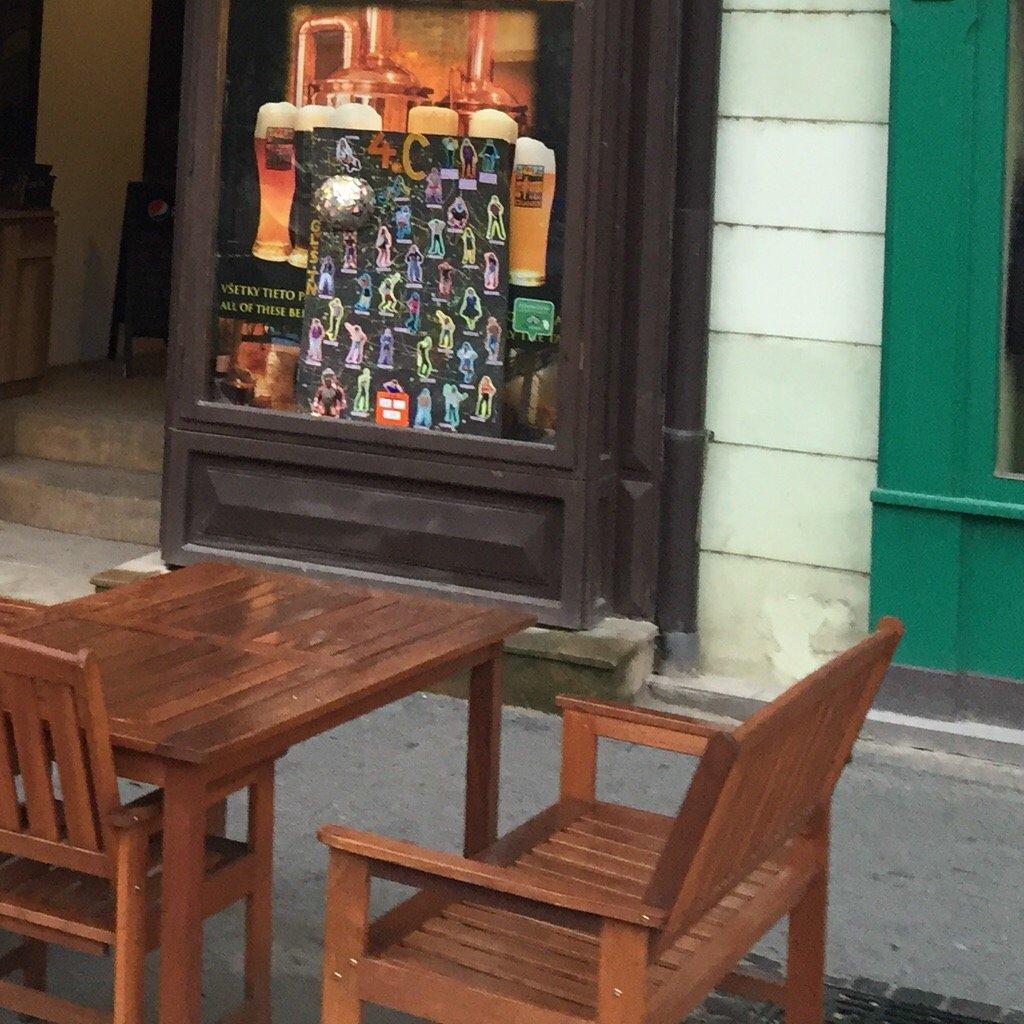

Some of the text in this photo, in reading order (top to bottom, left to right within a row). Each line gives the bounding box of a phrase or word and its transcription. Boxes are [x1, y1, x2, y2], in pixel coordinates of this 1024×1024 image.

[220, 282, 260, 297] VŠETKY
[263, 287, 296, 300] TIETO
[220, 301, 238, 312] ALL
[239, 302, 254, 313] OF
[256, 304, 287, 317] THESE
